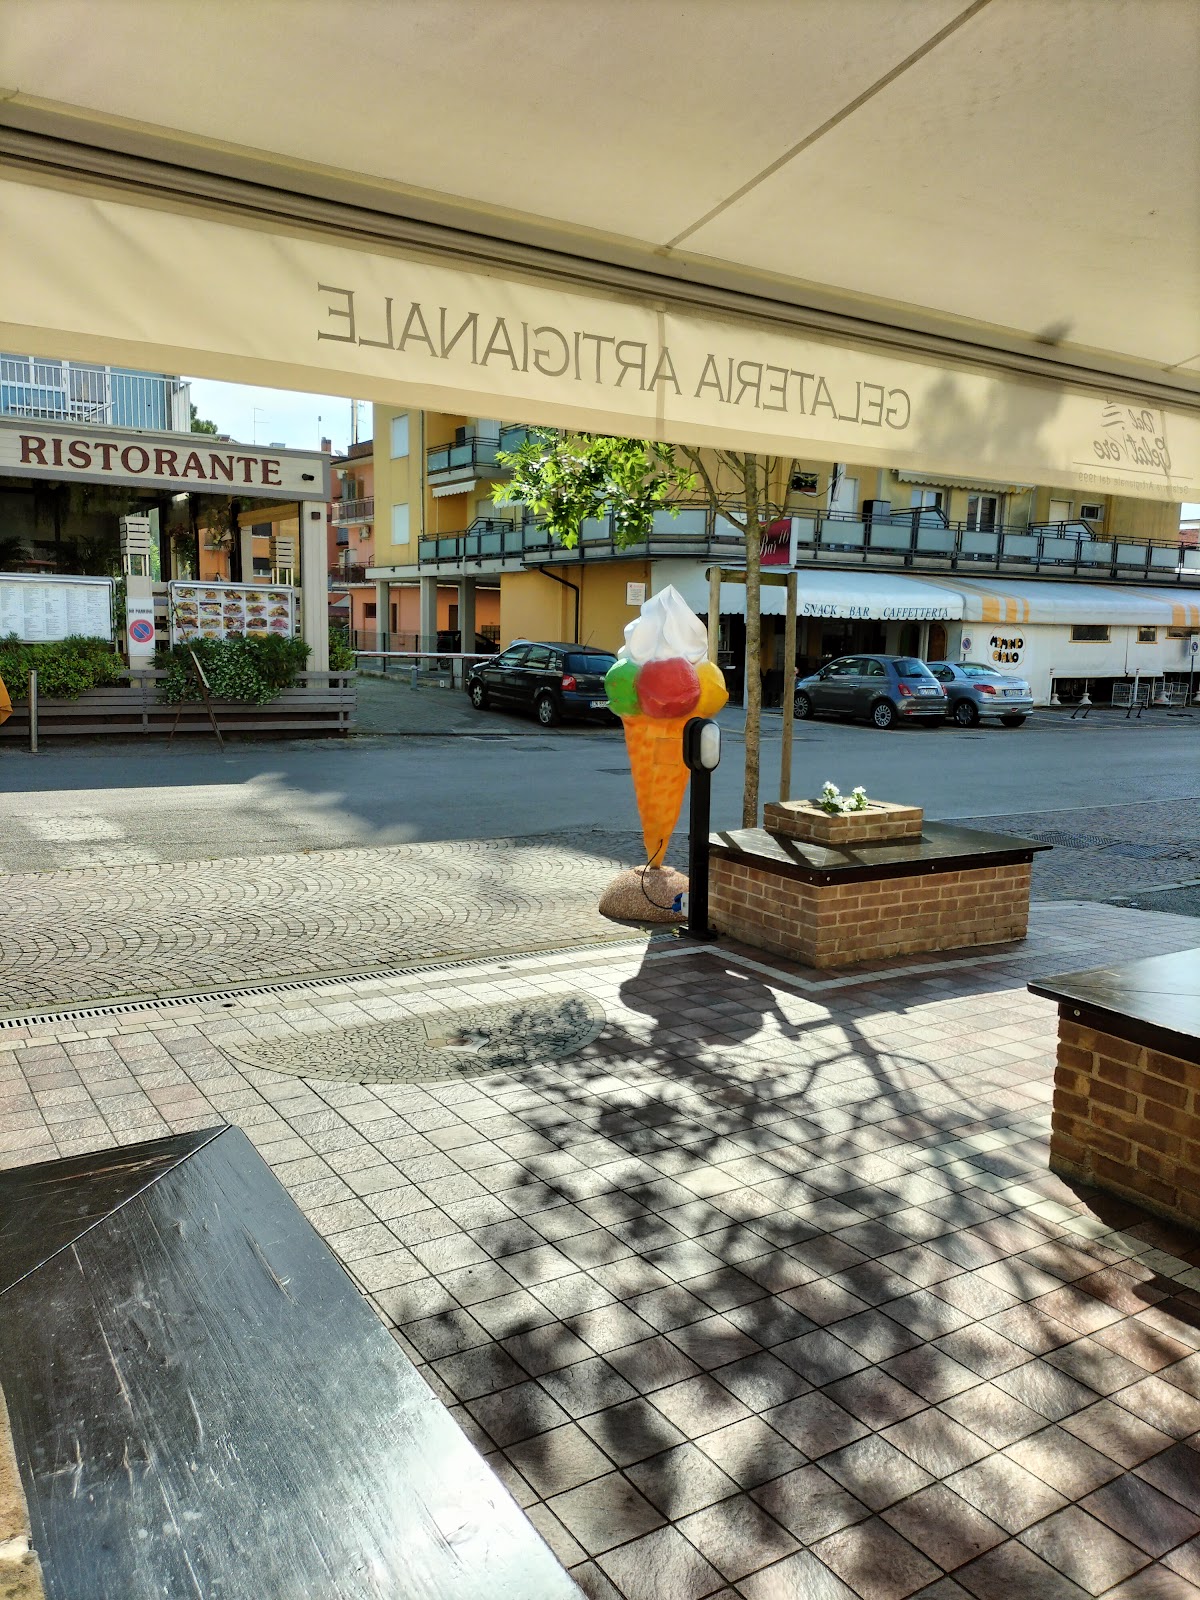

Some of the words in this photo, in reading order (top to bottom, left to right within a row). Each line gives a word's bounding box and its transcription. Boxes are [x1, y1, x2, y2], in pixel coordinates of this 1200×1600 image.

[19, 435, 282, 486] RISTORANTE
[803, 603, 838, 615] SNACK
[850, 606, 870, 617] BAR
[883, 606, 949, 618] CAFFETTERIA
